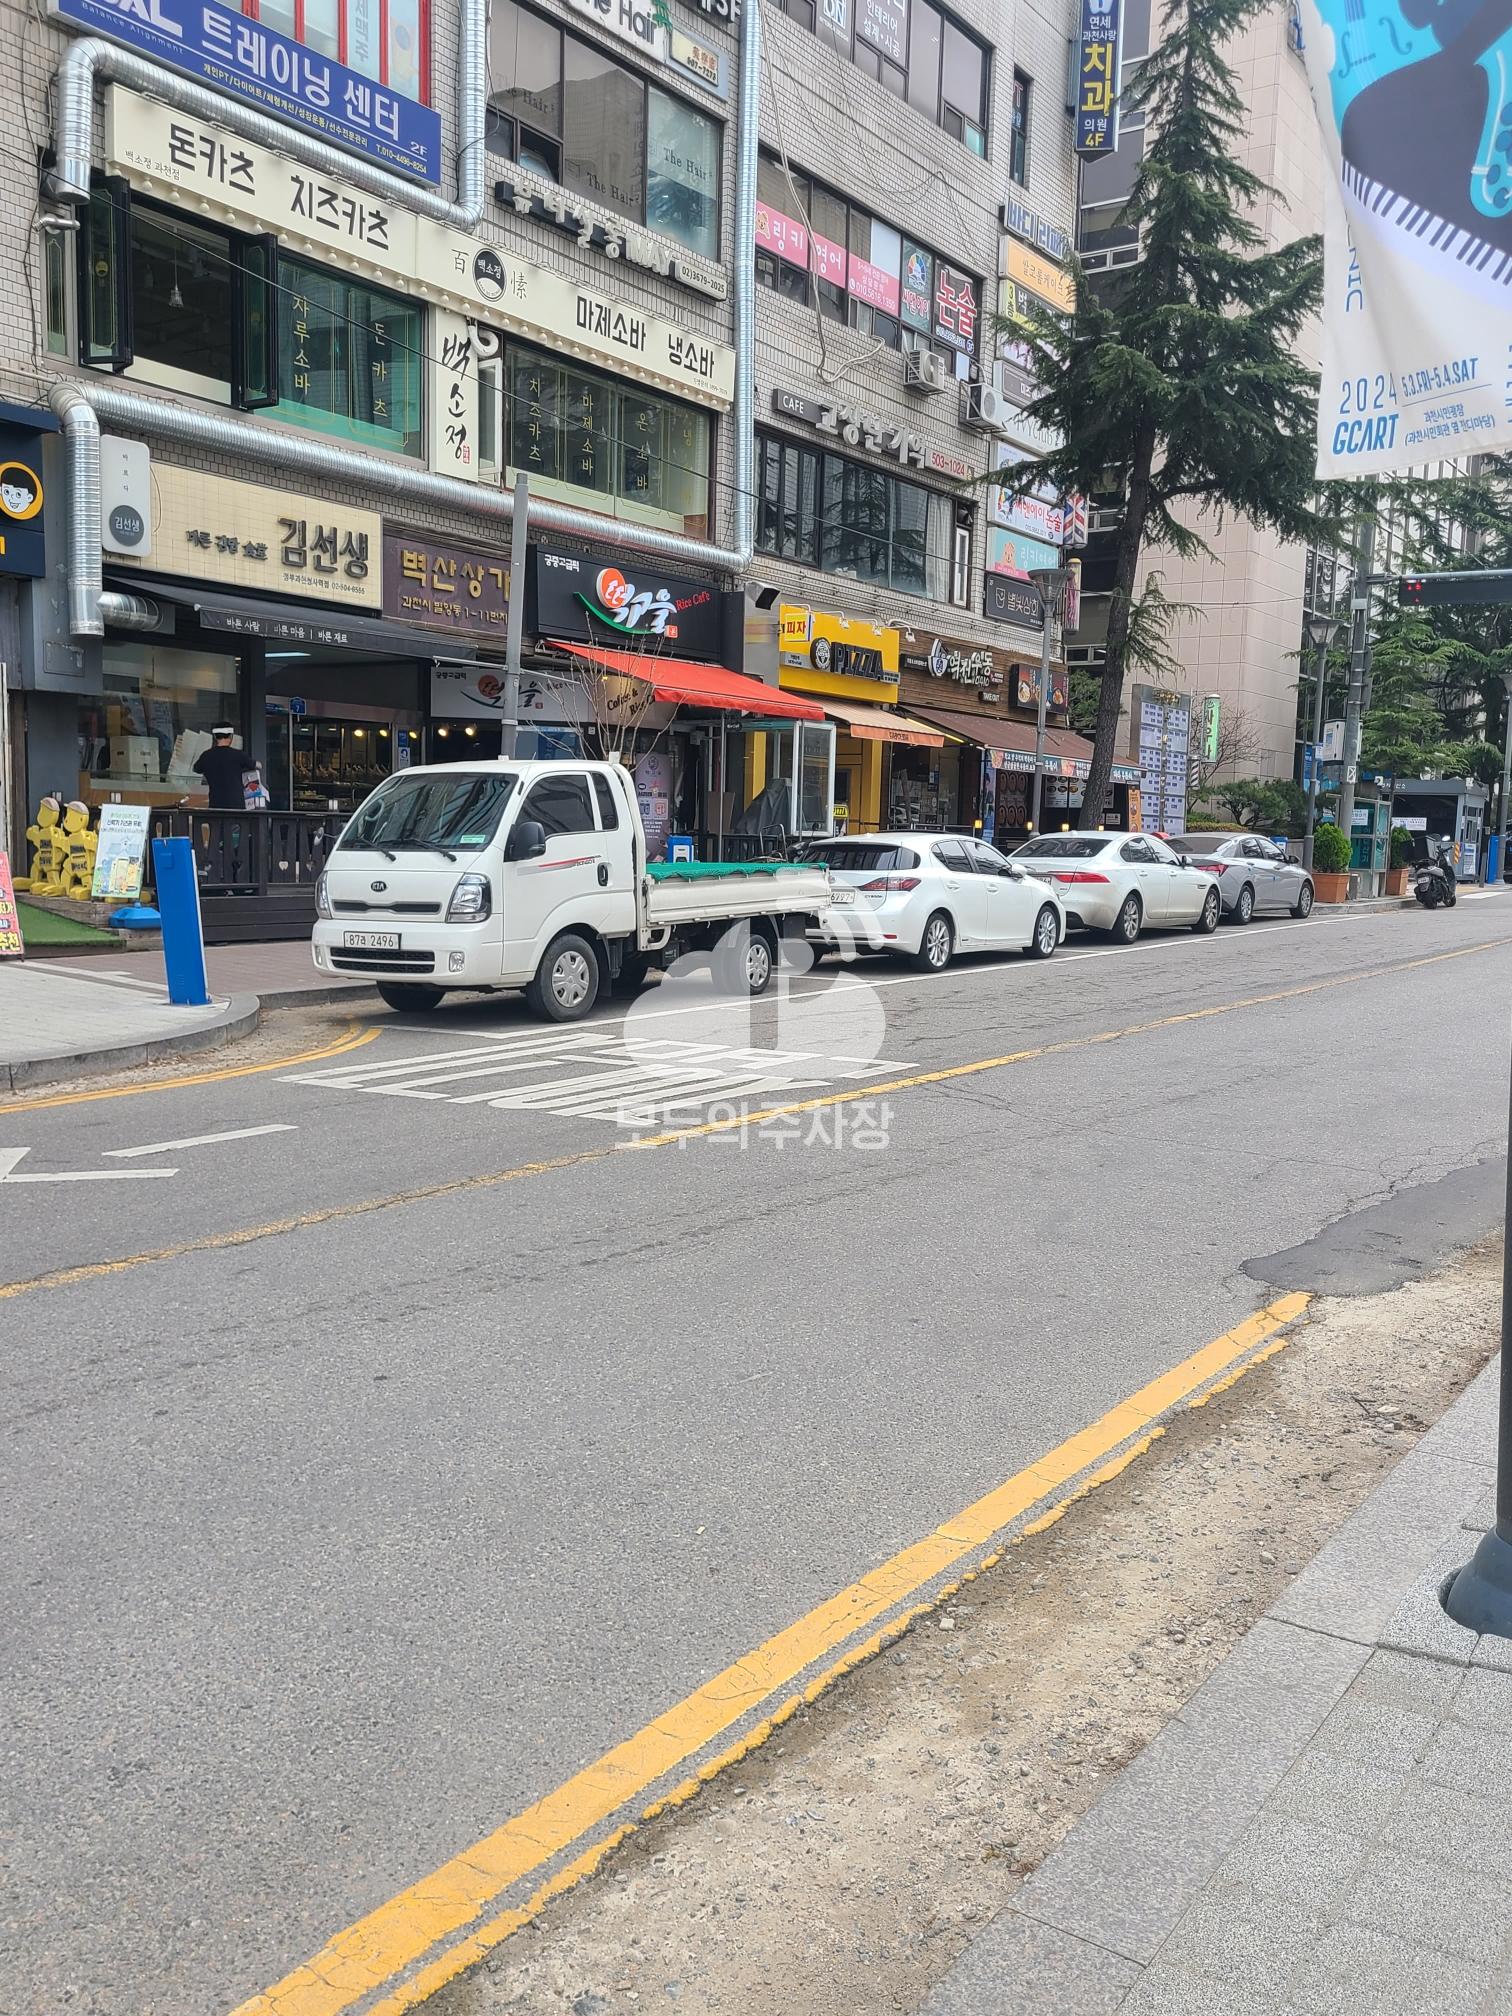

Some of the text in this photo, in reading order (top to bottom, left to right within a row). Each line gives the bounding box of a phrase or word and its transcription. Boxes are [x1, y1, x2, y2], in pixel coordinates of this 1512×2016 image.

[82, 3, 183, 55] Balance Alignment
[619, 0, 658, 44] Hair
[867, 0, 898, 35] 인테리어
[1089, 16, 1111, 29] 연세
[1083, 30, 1117, 42] 과천사랑
[203, 8, 428, 156] 트레이닝 센터 2F
[1082, 43, 1113, 116] 치과
[1084, 118, 1107, 131] 의원
[1085, 133, 1105, 147] 4F
[124, 150, 181, 182] 백소정 과천점
[168, 122, 256, 196] 돈카츠
[664, 147, 706, 180] The Hair
[587, 172, 606, 194] The
[290, 174, 390, 251] 치즈카츠
[477, 258, 502, 280] 백소정
[817, 244, 842, 274] 영어
[936, 270, 977, 338] 논술
[577, 295, 647, 352] 마제소바
[292, 295, 311, 396] 자루소바
[668, 333, 715, 379] 냉소바
[372, 323, 388, 418] 돈카츠
[1402, 358, 1478, 398] 5.3.FRI-5.4.SAT
[442, 333, 470, 459] 백소정
[783, 395, 804, 414] CAFE
[1340, 372, 1398, 415] 2024
[528, 377, 542, 462] 치즈카츠
[1424, 403, 1465, 424] 과천시민광장
[581, 393, 594, 477] 마제소바
[1332, 413, 1399, 455] GCART
[932, 453, 965, 476] 503-1024
[115, 516, 140, 532] 김선생
[278, 517, 369, 578] 김선생
[545, 554, 580, 572] 궁중고급떡
[403, 549, 511, 602] 벽산상가
[402, 596, 432, 612] 과천시
[676, 591, 711, 611] Rice Cafe
[1008, 592, 1039, 617] 별빛상회
[227, 618, 261, 633] 바른 사람
[274, 623, 305, 639] 바른 마음
[318, 629, 348, 643] 바른 재료
[787, 621, 806, 634] 피자
[831, 642, 884, 680] PIZZA
[949, 650, 994, 684] 역전우동
[372, 882, 387, 891] KIA
[370, 934, 394, 947] 2496
